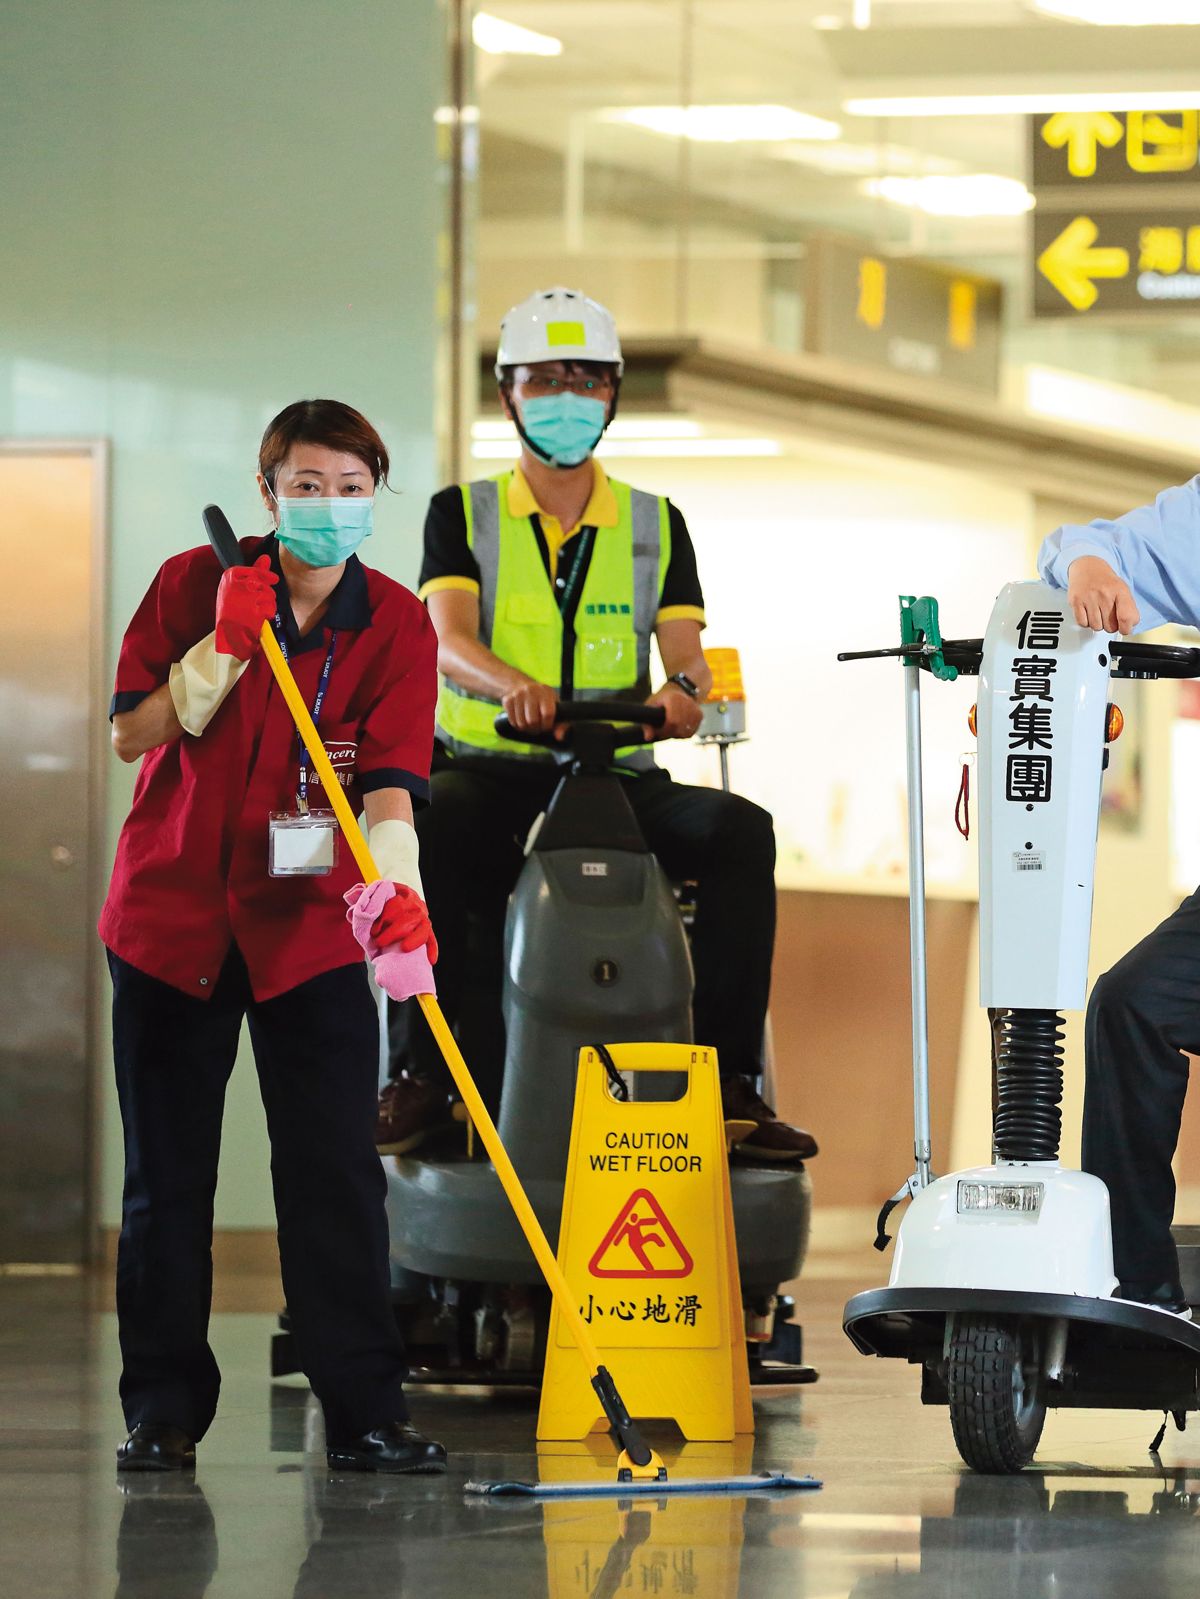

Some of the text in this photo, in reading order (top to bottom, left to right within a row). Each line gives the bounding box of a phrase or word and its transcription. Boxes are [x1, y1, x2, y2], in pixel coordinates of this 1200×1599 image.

[1005, 610, 1064, 802] 信實集團
[605, 1132, 689, 1150] CAUTION
[590, 1155, 702, 1173] WET FLOOR
[579, 1294, 703, 1327] 小心地滑
